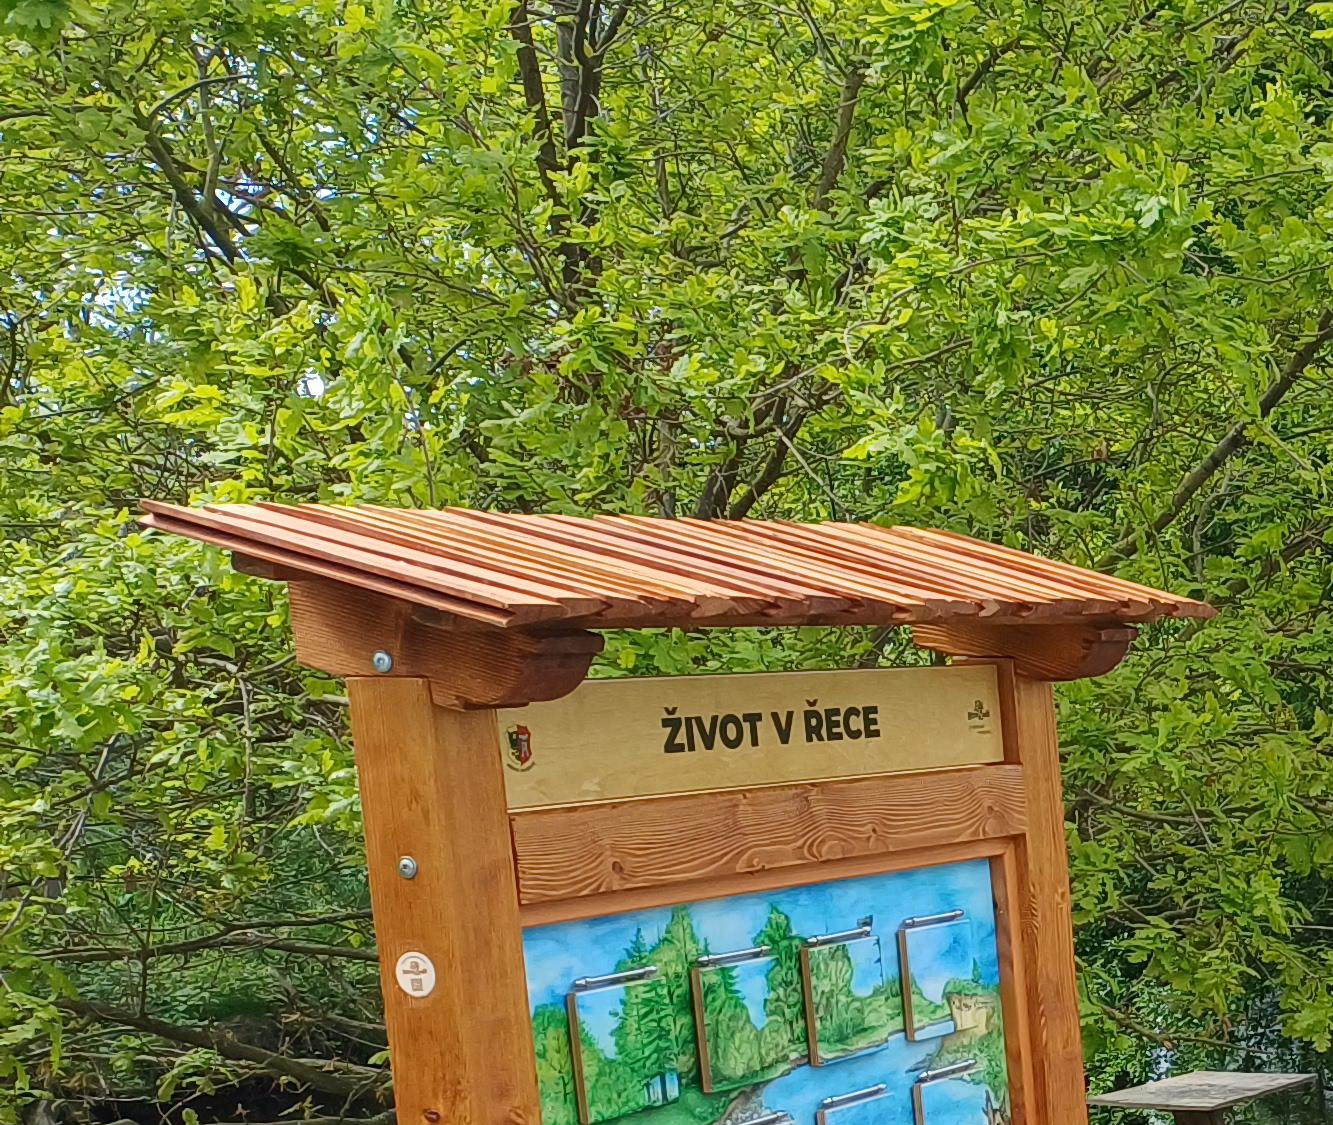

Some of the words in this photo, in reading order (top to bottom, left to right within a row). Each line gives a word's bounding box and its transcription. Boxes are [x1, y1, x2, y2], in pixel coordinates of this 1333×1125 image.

[661, 706, 763, 753] ŽIVOT
[771, 710, 795, 745] V
[803, 699, 881, 743] ŘECE
